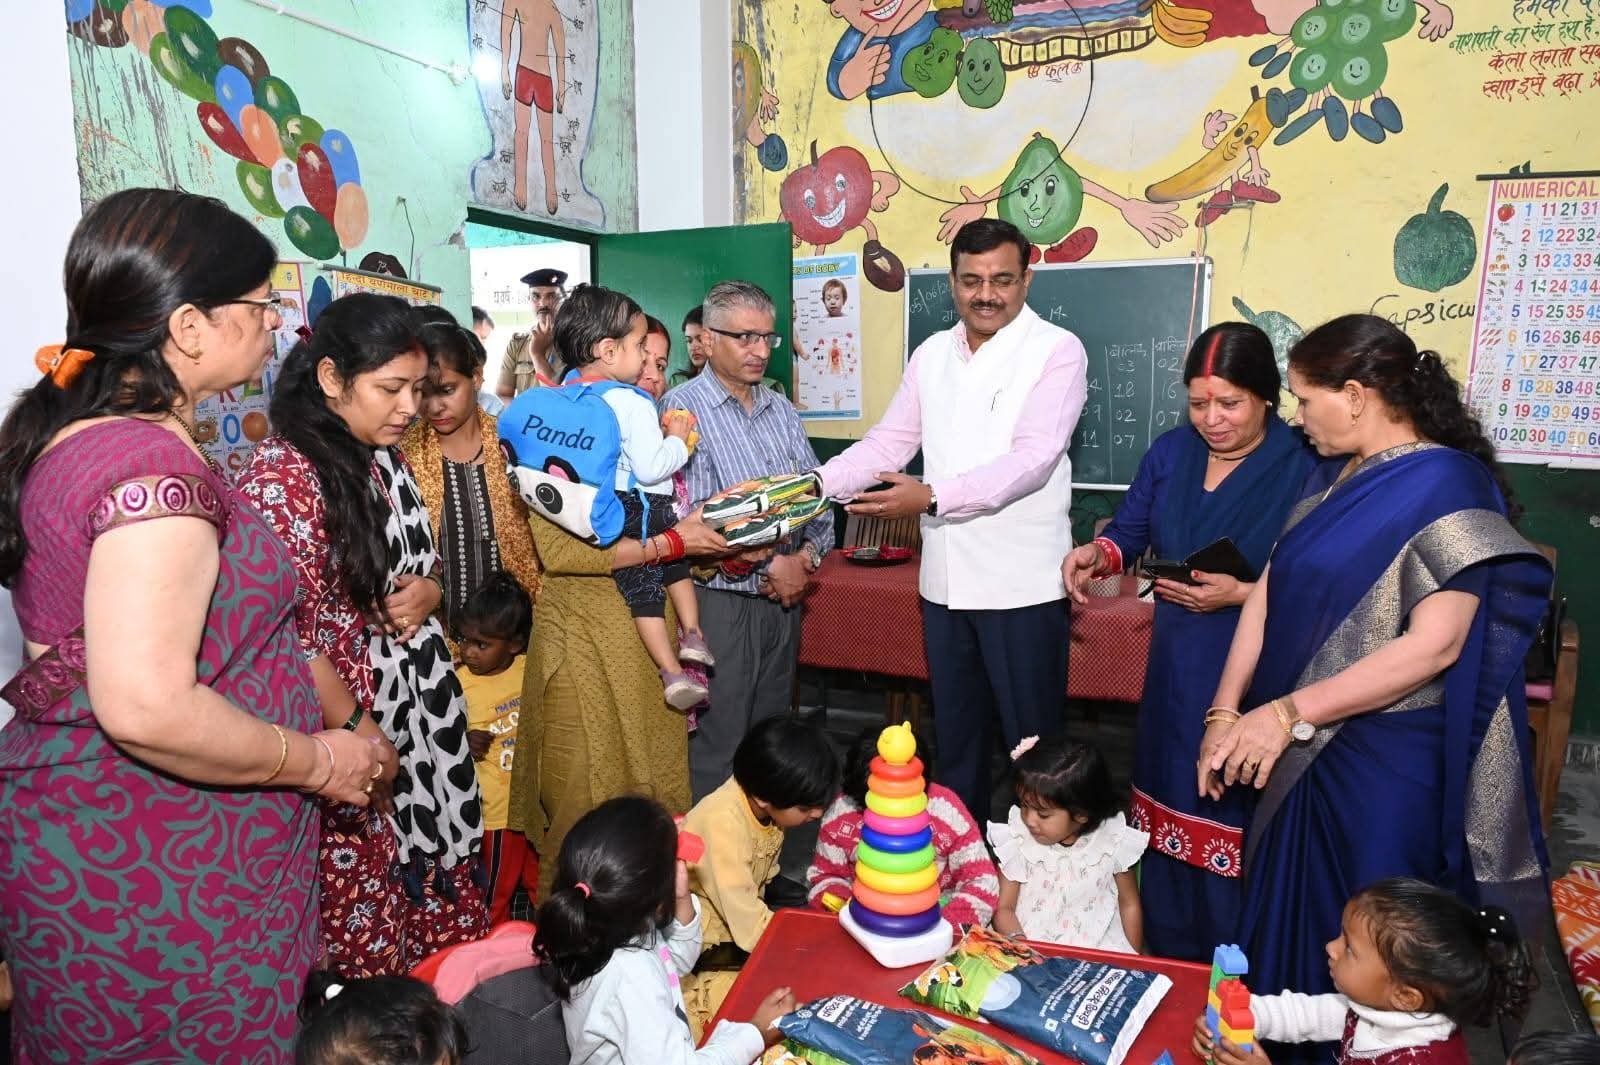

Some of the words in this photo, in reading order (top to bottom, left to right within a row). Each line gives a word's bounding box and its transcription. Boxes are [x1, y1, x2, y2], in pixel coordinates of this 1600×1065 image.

[1504, 27, 1530, 48] का
[1488, 50, 1527, 74] केला
[1529, 47, 1576, 72] लगता
[1517, 73, 1547, 100] इसे
[1498, 181, 1600, 198] NUMERICAL
[1525, 203, 1532, 217] 1
[1541, 203, 1557, 217] 11
[1560, 202, 1577, 216] 21
[1581, 202, 1598, 216] 31
[1521, 229, 1531, 243] 2
[1538, 228, 1553, 243] 12
[1556, 228, 1575, 242] 22
[1577, 227, 1595, 242] 32
[816, 263, 840, 273] BODY
[1518, 254, 1527, 268] 3
[1534, 254, 1551, 268] 13
[1553, 254, 1571, 268] 23
[1573, 253, 1591, 267] 33
[1514, 279, 1523, 293] 4
[1531, 279, 1547, 293] 14
[1549, 279, 1567, 293] 24
[1569, 279, 1587, 293] 34
[1369, 294, 1475, 332] Capsicu
[1511, 304, 1520, 318] 5
[1528, 304, 1544, 318] 15
[1546, 304, 1564, 318] 25
[1566, 304, 1584, 319] 35
[1508, 329, 1517, 343] 6
[1524, 329, 1540, 343] 16
[1543, 330, 1560, 344] 26
[1562, 330, 1580, 344] 36
[1506, 354, 1515, 367] 7
[1521, 355, 1538, 368] 17
[1539, 355, 1558, 369] 27
[1559, 355, 1578, 369] 37
[1578, 356, 1597, 370] 47
[1113, 381, 1135, 398] 18
[1502, 378, 1511, 392] 8
[1518, 379, 1534, 393] 18
[1536, 379, 1553, 393] 28
[1555, 380, 1573, 394] 38
[1575, 381, 1594, 395] 48
[1156, 410, 1180, 426] 07
[1498, 403, 1508, 417] 9
[1514, 403, 1530, 417] 19
[1532, 404, 1550, 418] 29
[1552, 405, 1571, 419] 39
[1571, 406, 1590, 420] 49
[1591, 407, 1600, 421] 5
[521, 414, 596, 451] Panda
[1492, 427, 1508, 441] 10
[1510, 428, 1527, 442] 20
[1529, 428, 1546, 443] 30
[1548, 430, 1566, 444] 40
[1589, 432, 1600, 446] 6
[1113, 434, 1135, 449] 07
